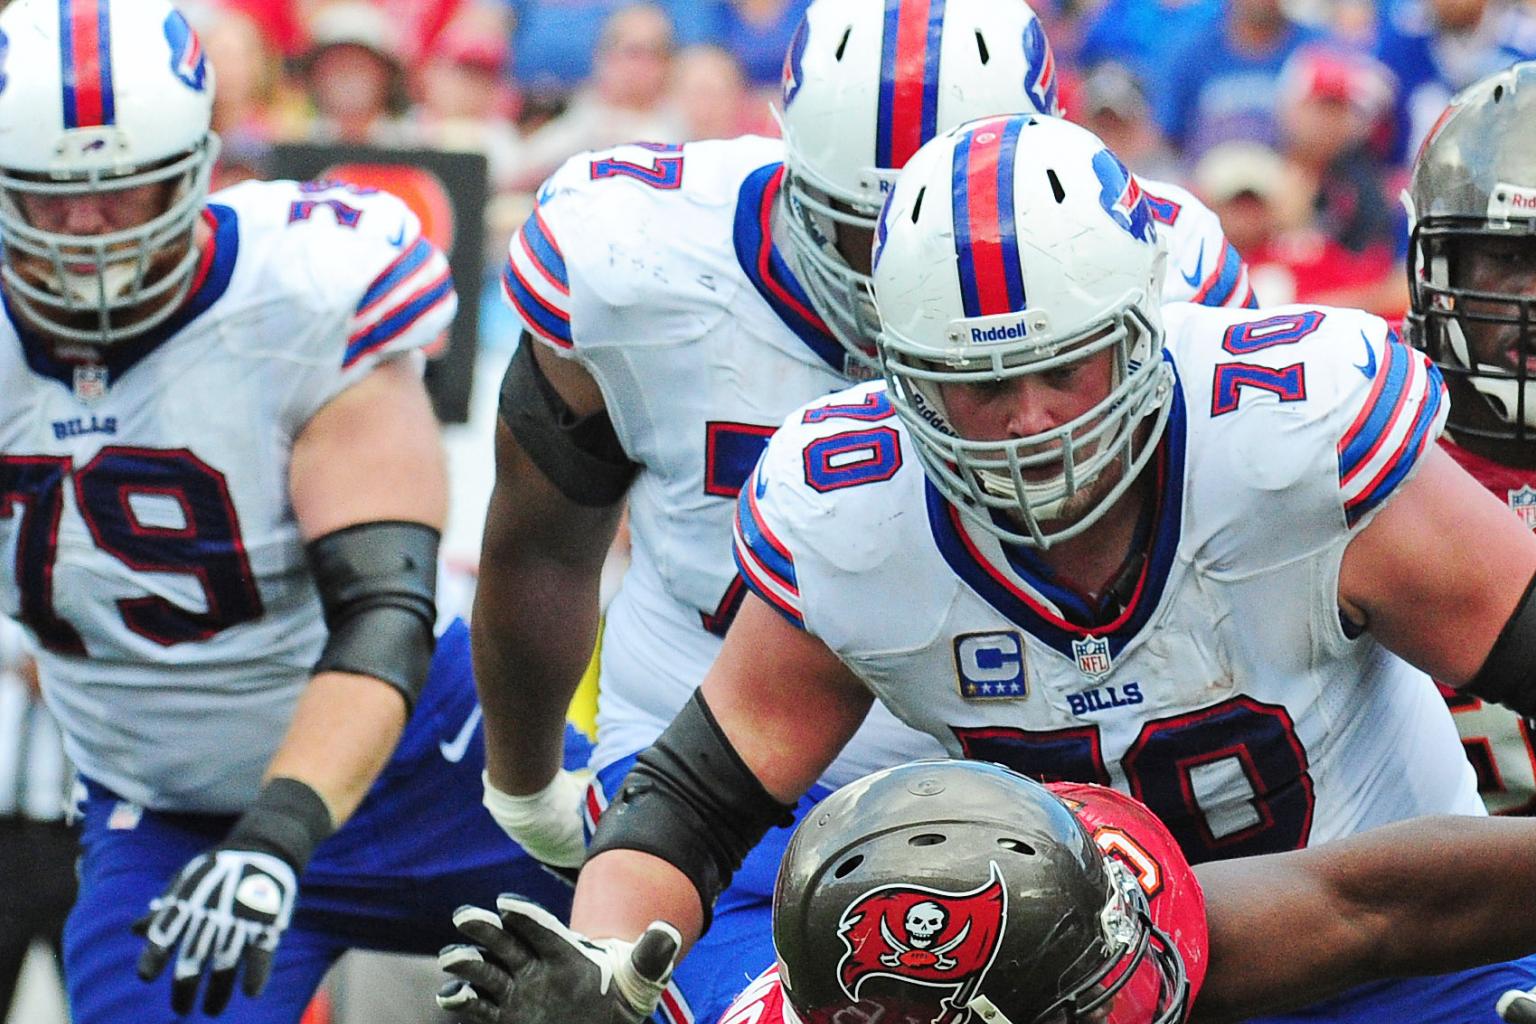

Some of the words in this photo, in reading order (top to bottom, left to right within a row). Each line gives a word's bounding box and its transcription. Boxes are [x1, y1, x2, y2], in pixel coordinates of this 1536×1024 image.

[590, 141, 684, 190] 7
[971, 322, 1027, 344] Riddell
[1211, 310, 1326, 418] 70
[53, 416, 117, 440] BILLS
[801, 388, 904, 494] 70
[0, 445, 265, 660] 79
[958, 635, 1020, 682] C
[1080, 655, 1108, 673] NFL
[1066, 682, 1145, 717] BILLS
